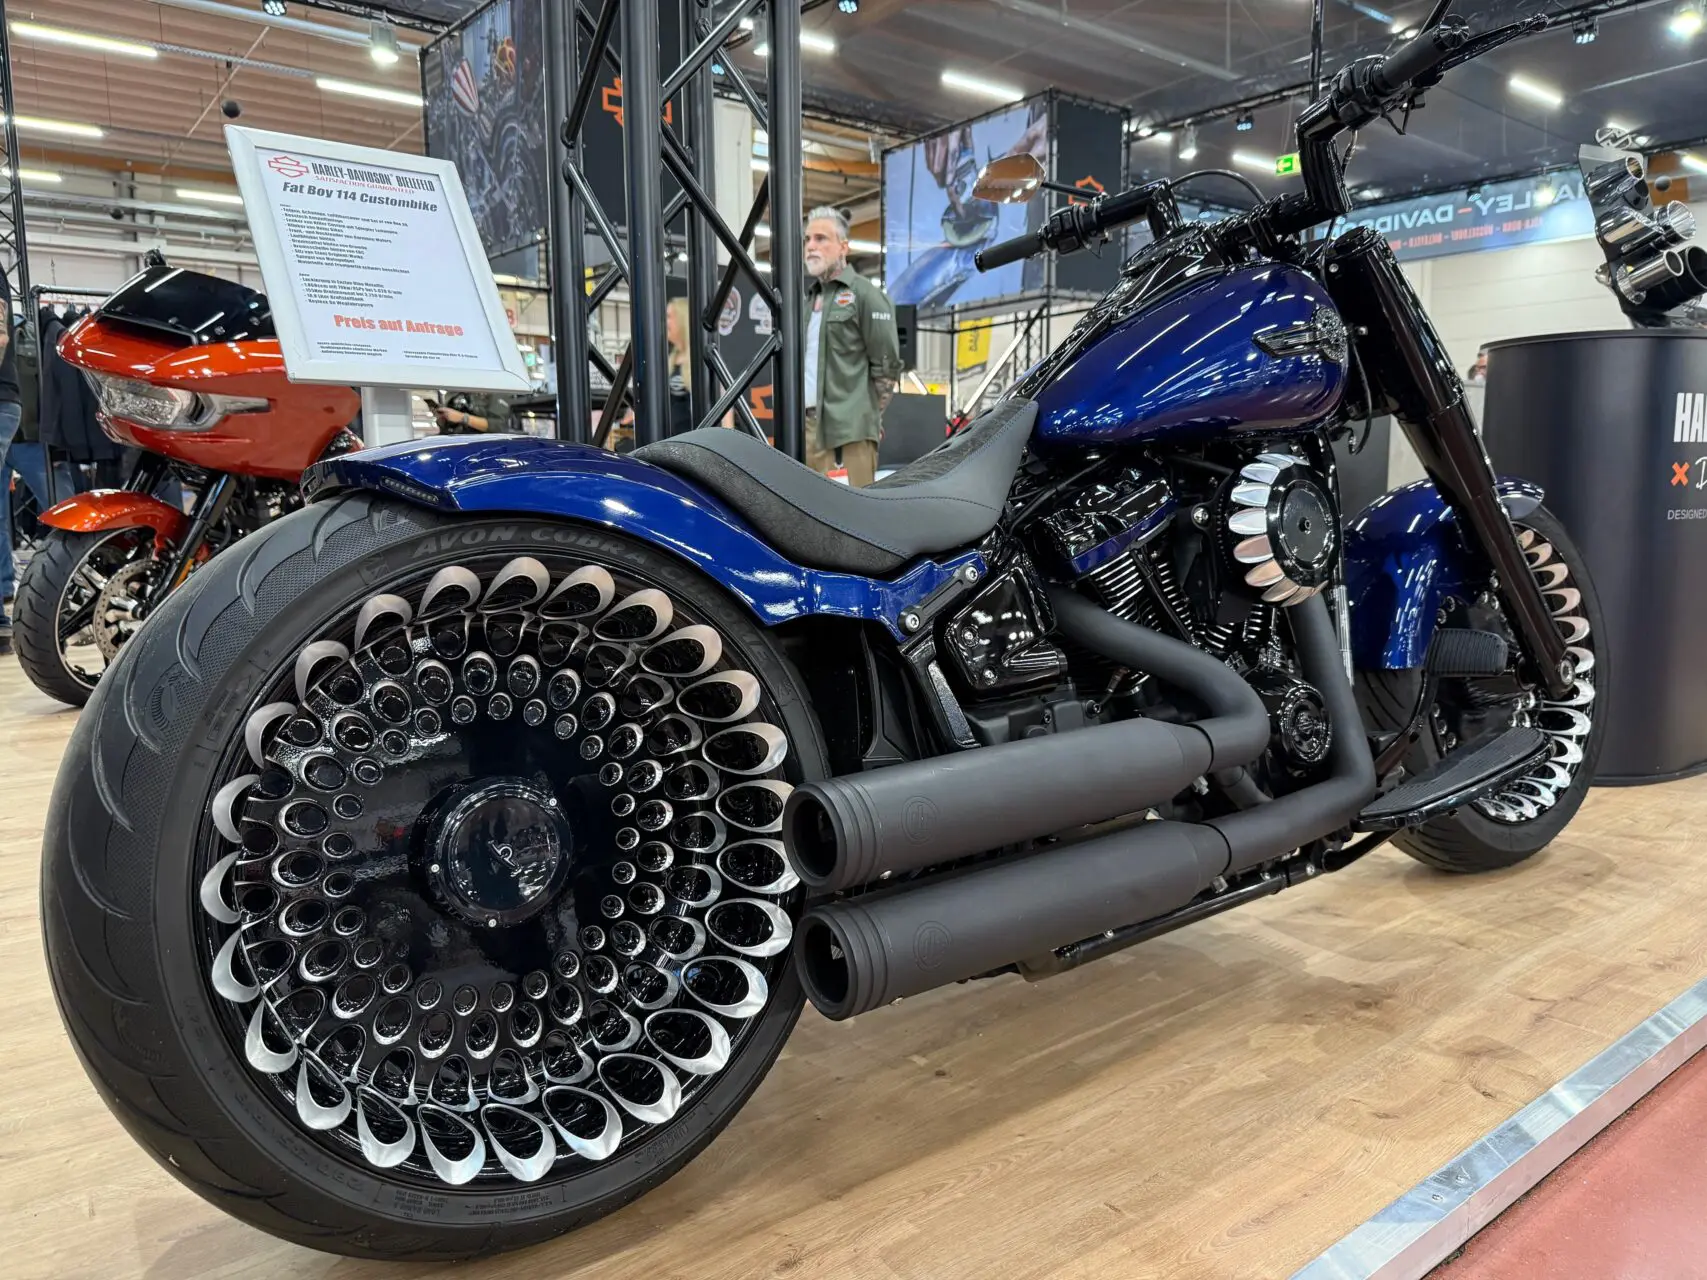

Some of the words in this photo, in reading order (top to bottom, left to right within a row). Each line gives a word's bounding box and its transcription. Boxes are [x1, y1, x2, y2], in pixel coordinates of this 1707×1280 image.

[315, 176, 365, 187] SATISFACTION
[367, 183, 414, 194] GUARANTEED
[396, 176, 435, 191] BIELEFELD
[283, 182, 303, 193] Fat
[307, 185, 333, 198] Boy
[336, 190, 356, 201] 114
[360, 193, 437, 211] Custombike
[334, 315, 375, 329] Preis
[378, 320, 404, 331] auf
[406, 320, 463, 336] Anfrage
[1673, 392, 1707, 443] HA
[411, 525, 520, 558] AVON
[531, 526, 645, 565] COBRA
